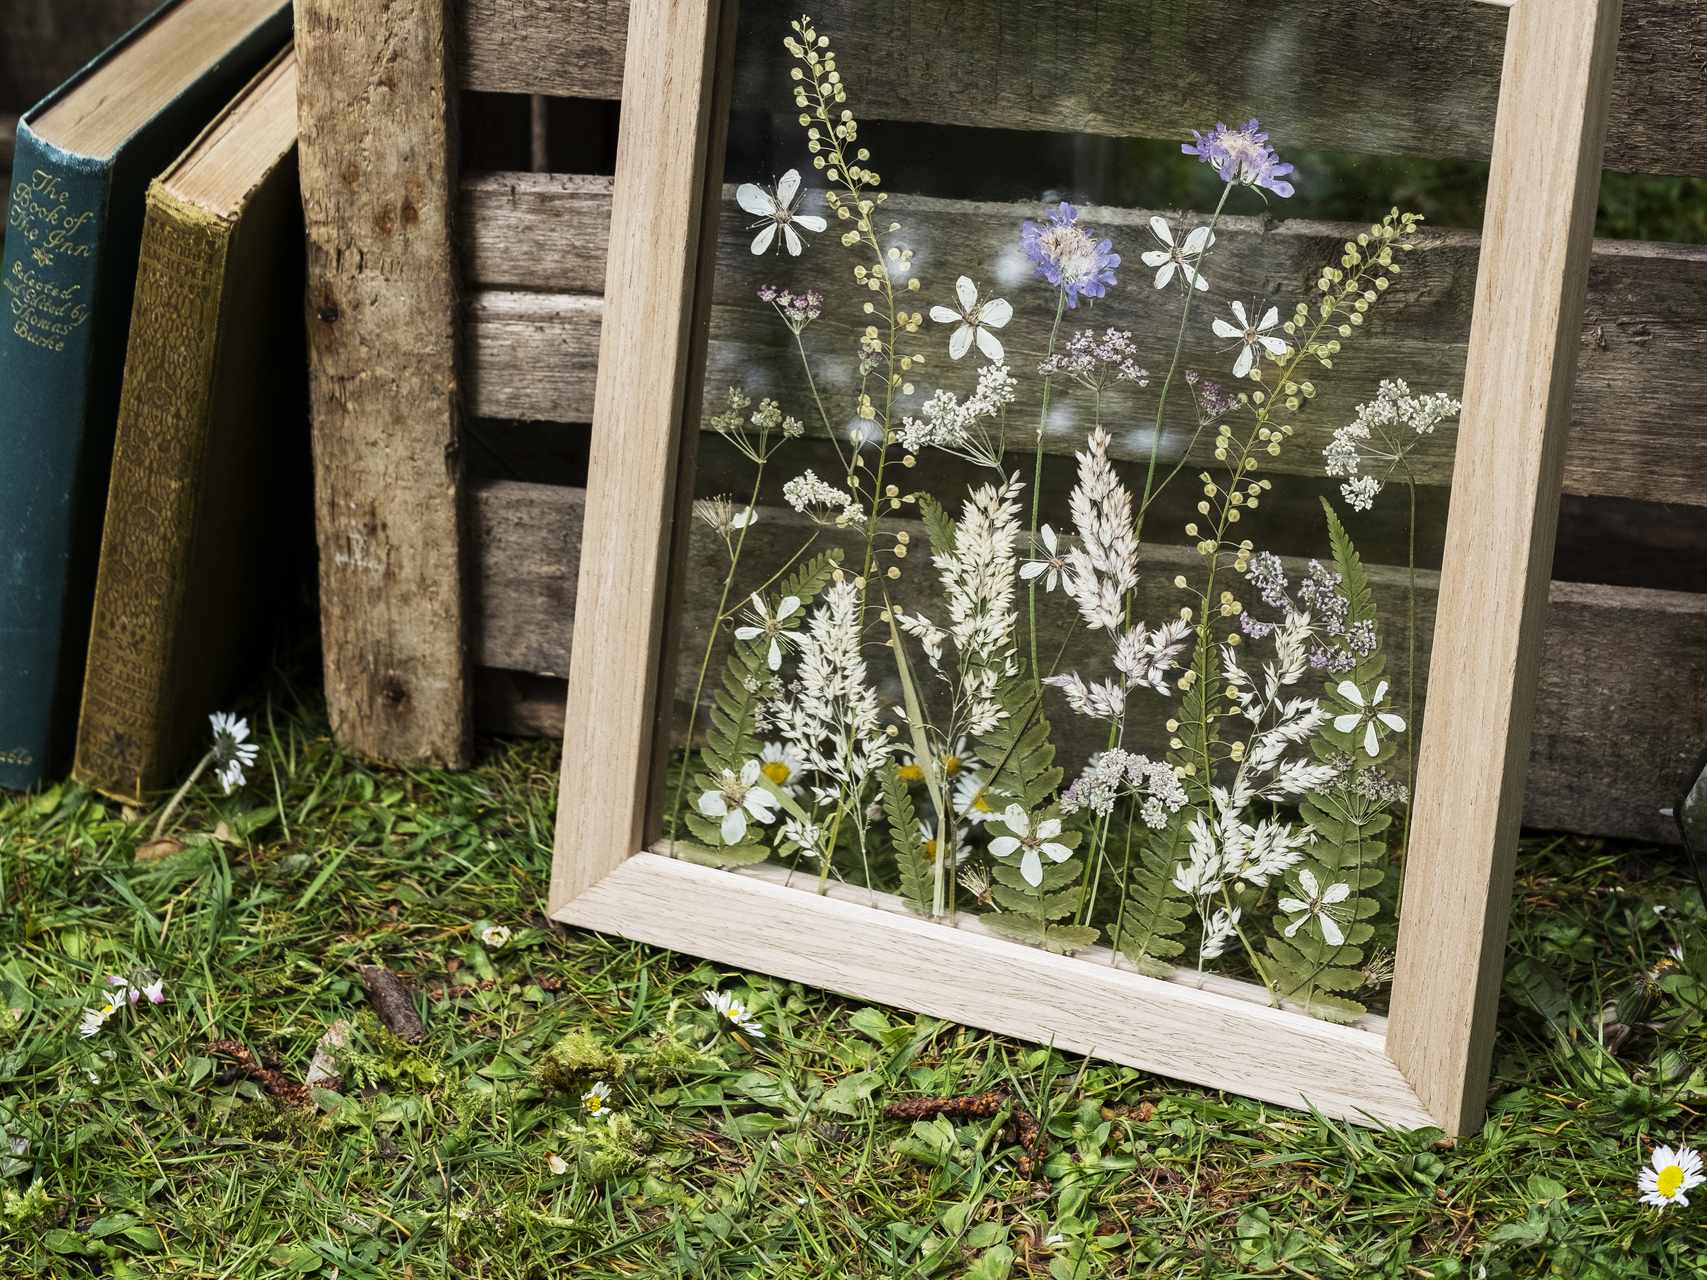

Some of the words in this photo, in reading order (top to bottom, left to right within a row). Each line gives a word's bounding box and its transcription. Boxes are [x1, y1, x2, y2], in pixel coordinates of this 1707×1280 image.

[32, 169, 69, 202] The
[13, 182, 67, 225] Book
[63, 210, 94, 237] of
[43, 229, 89, 257] Inn
[12, 260, 80, 300] Selected
[10, 297, 73, 335] Thomas
[71, 303, 91, 327] by
[13, 320, 65, 352] Burke
